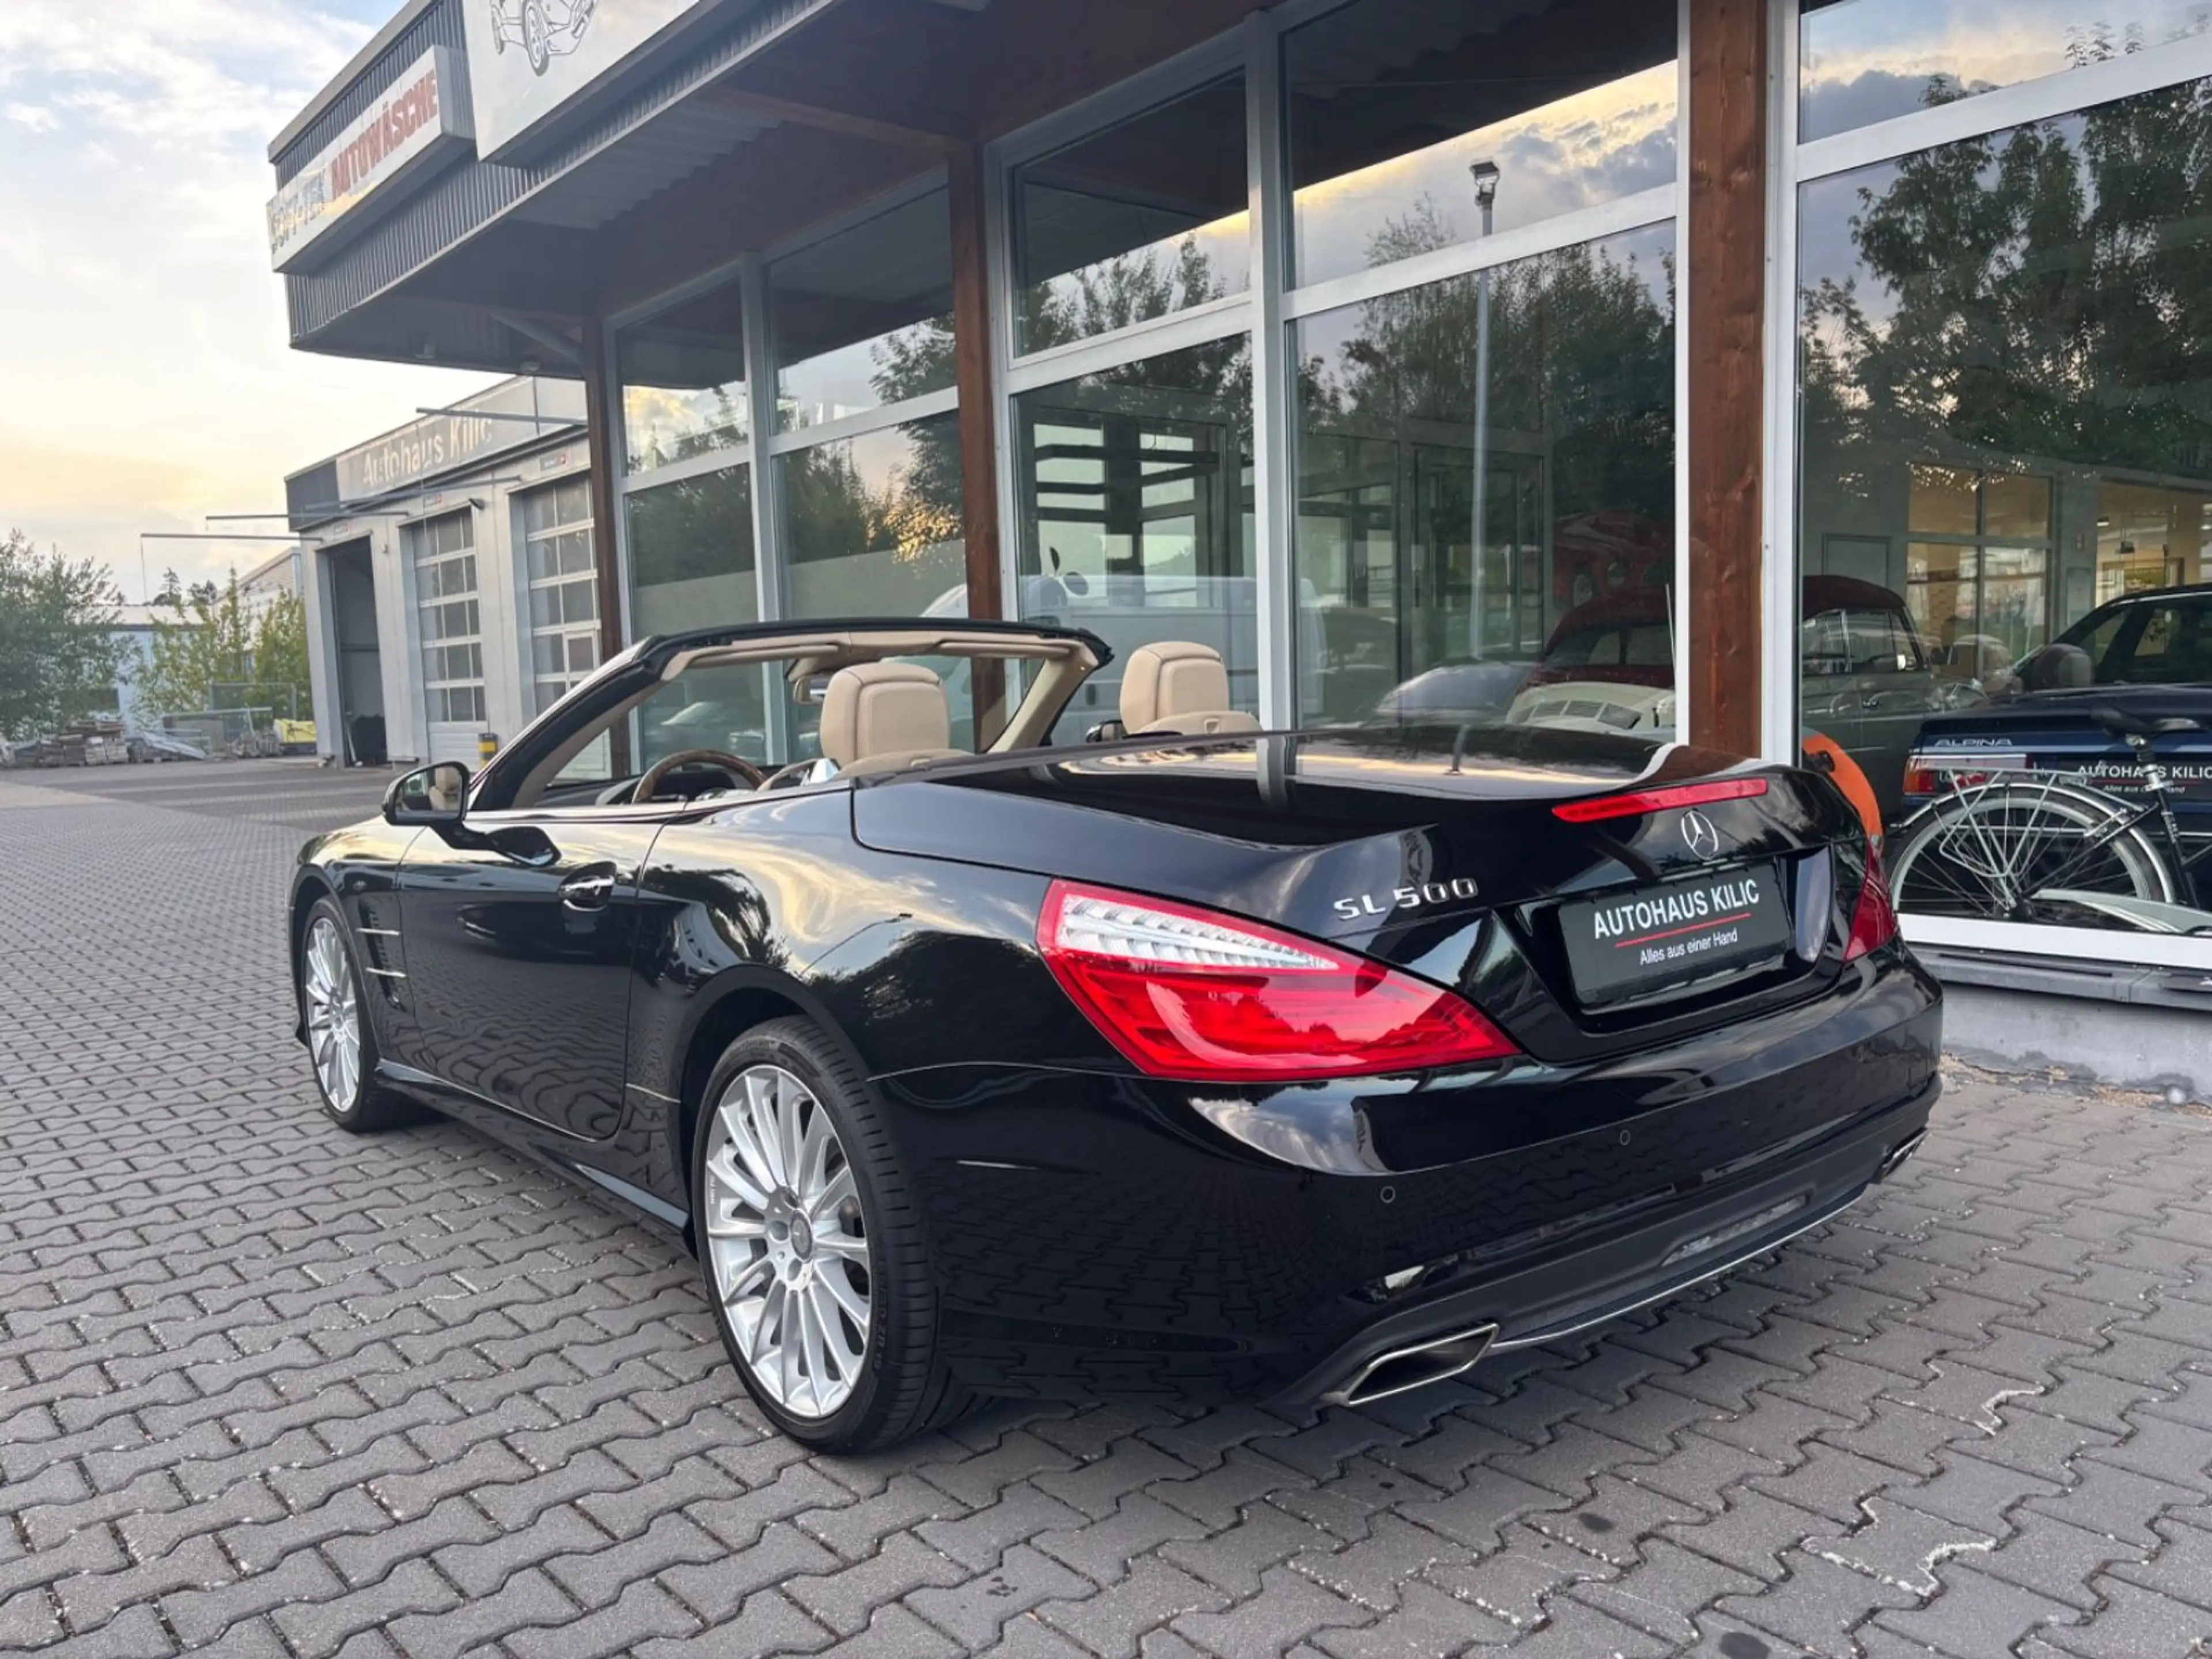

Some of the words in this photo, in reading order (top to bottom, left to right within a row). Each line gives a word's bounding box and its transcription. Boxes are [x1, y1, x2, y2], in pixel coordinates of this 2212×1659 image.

[363, 433, 444, 487] Autohaus
[1934, 738, 2013, 747] ALPINA
[2078, 766, 2166, 778] AUTOHAS
[2172, 766, 2212, 778] KILIC
[1334, 894, 1386, 921] SL
[1392, 878, 1478, 908] 500
[1593, 890, 1708, 940] AUTOHAUS
[1711, 878, 1760, 912] KILIC
[1639, 948, 1665, 966] Alles
[1667, 946, 1685, 959] aus
[1687, 938, 1711, 954] einer
[1713, 927, 1738, 947] Hand
